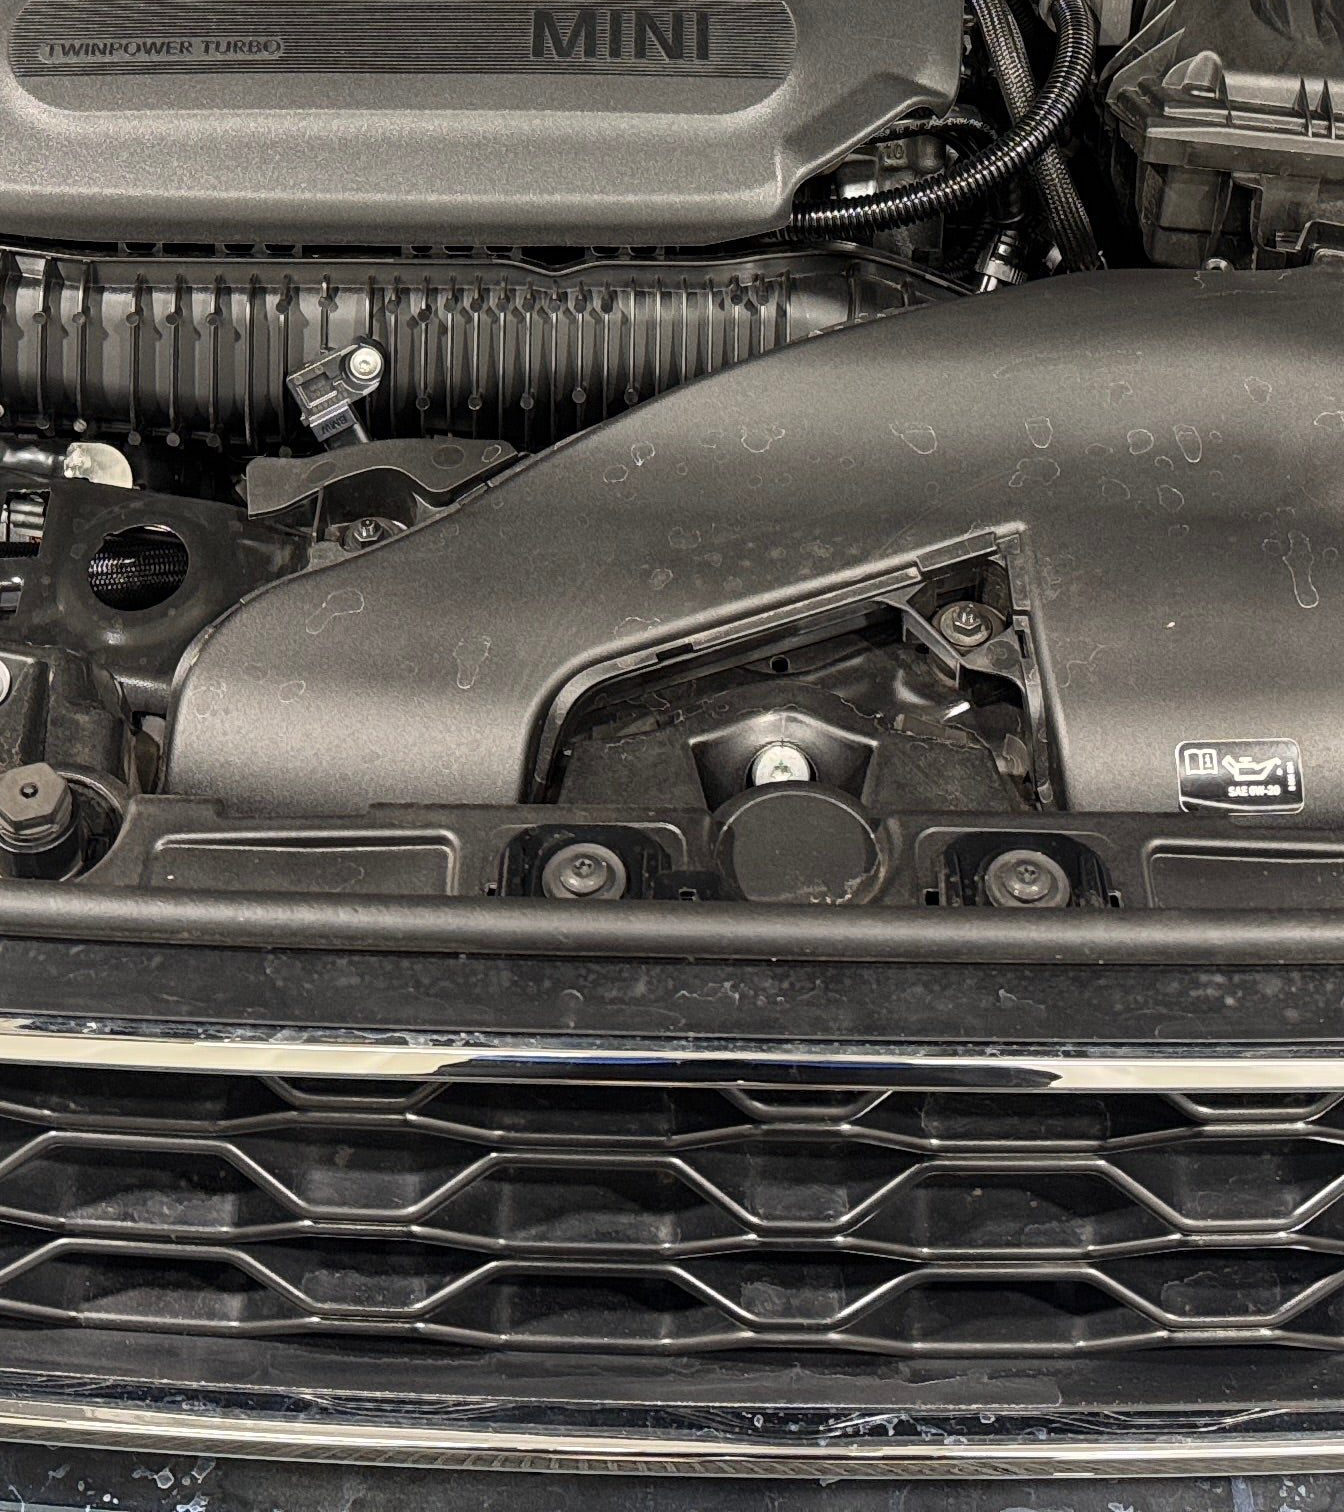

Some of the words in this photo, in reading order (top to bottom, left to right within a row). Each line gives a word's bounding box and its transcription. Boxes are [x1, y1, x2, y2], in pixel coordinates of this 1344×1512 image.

[531, 9, 710, 61] MINI
[47, 40, 193, 58] TWINPOWER
[201, 39, 282, 56] TURBO
[1227, 785, 1249, 797] SAE
